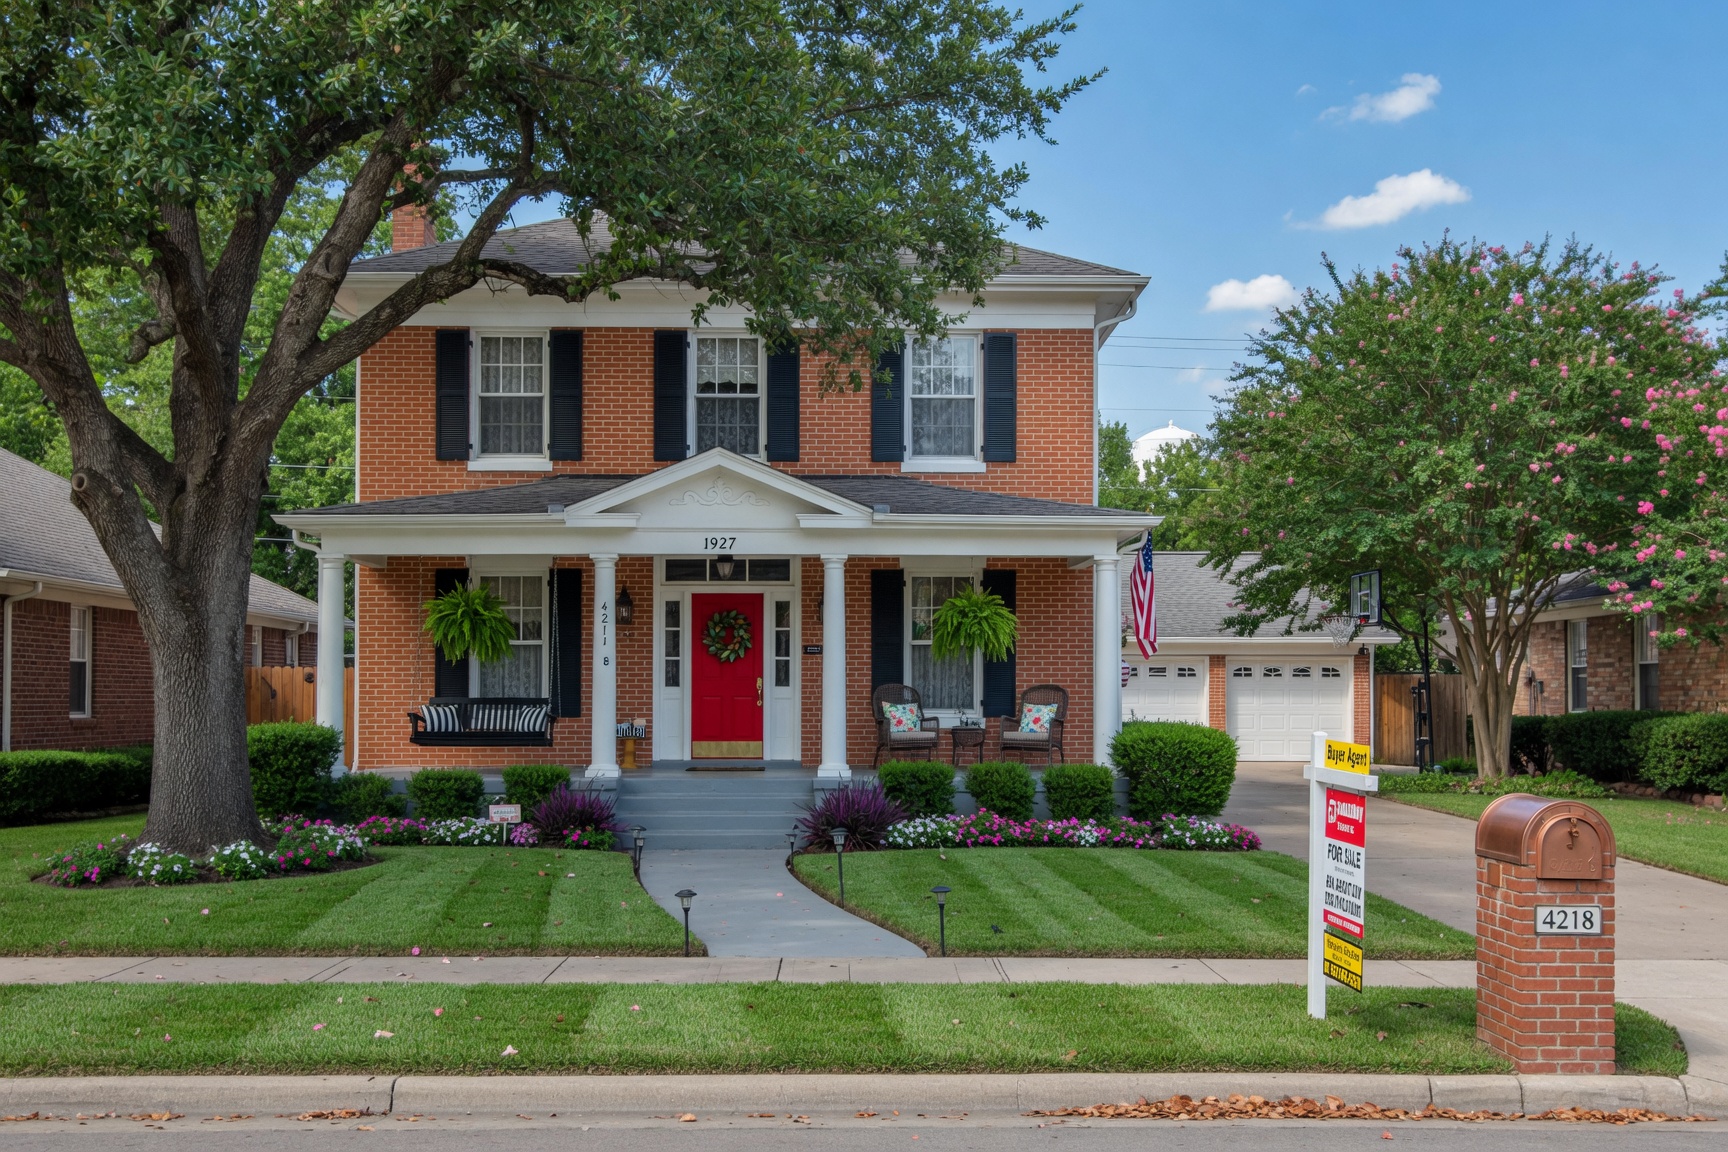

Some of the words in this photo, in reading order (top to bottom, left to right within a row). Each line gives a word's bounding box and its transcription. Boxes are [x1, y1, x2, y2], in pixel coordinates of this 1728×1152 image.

[704, 537, 737, 550] 1927
[1327, 843, 1343, 863] FOR
[1542, 909, 1594, 930] 4218
